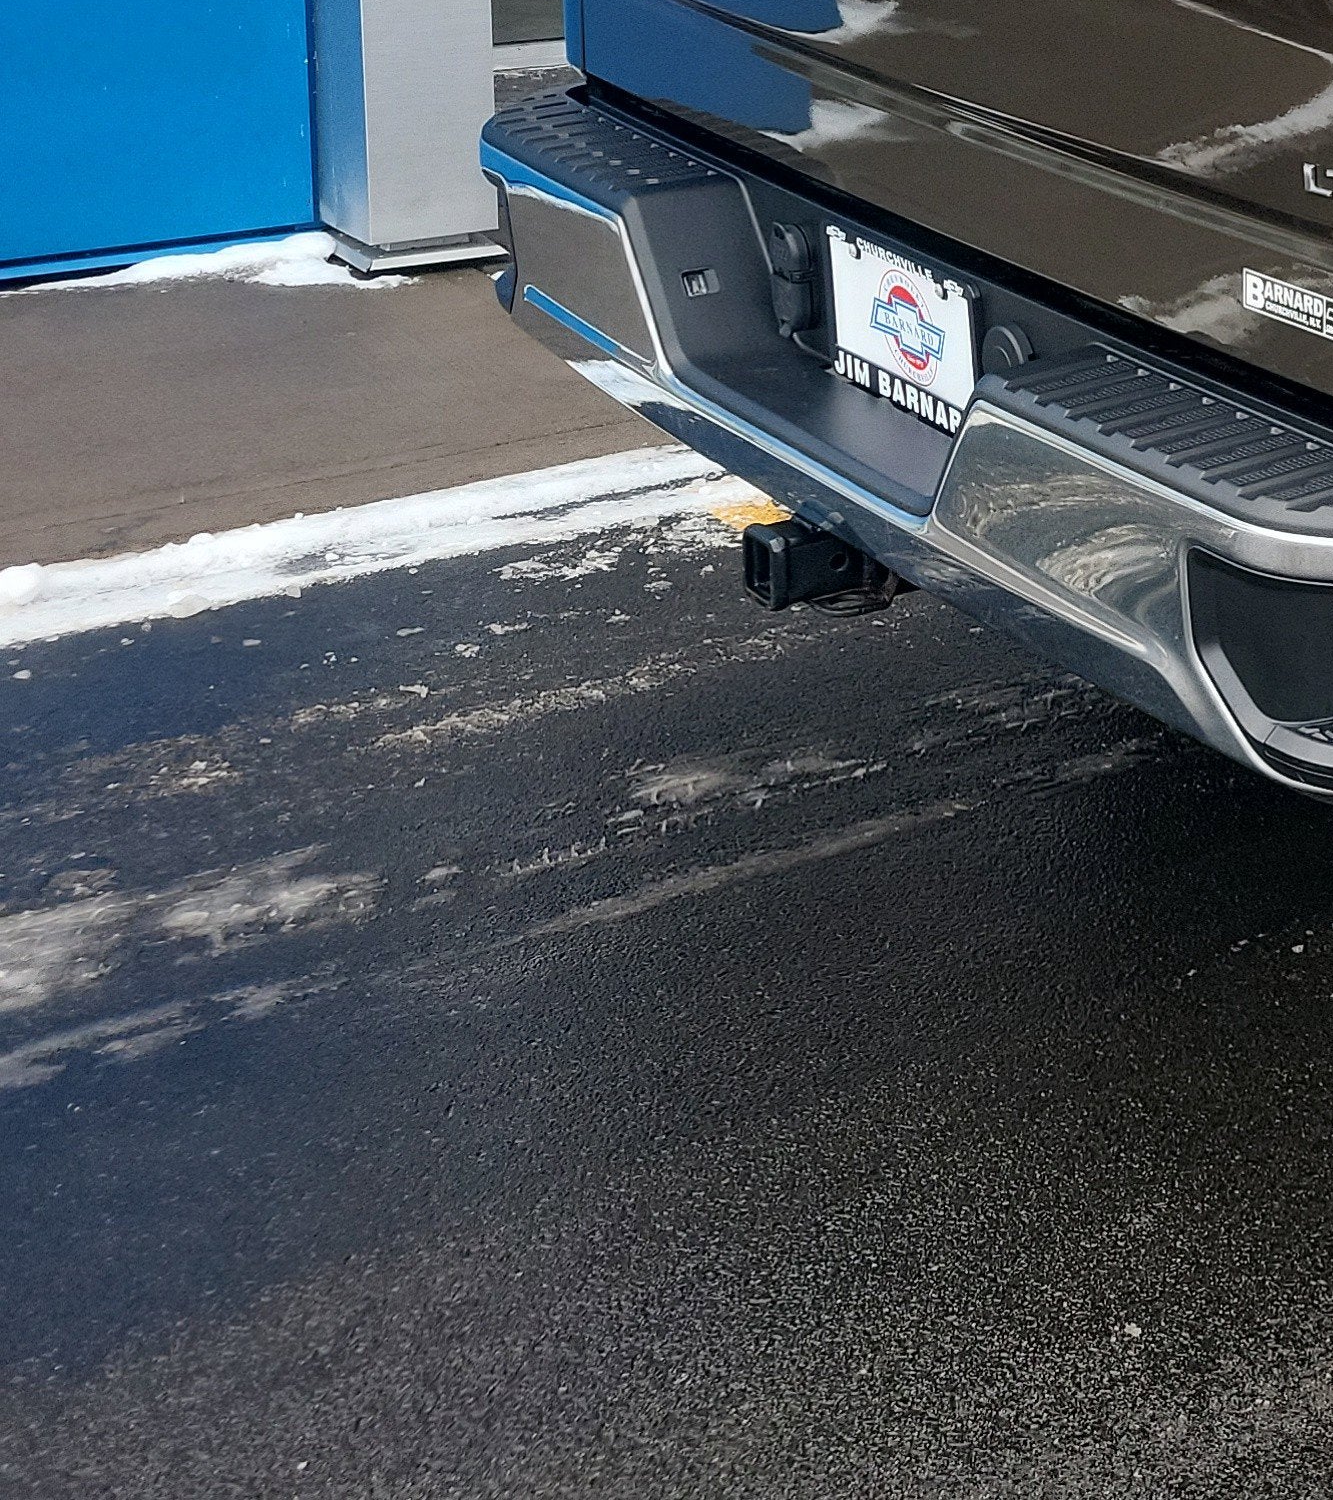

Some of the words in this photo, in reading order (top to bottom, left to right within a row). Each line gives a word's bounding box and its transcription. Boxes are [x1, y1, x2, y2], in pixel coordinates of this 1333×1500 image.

[856, 237, 934, 281] CHURCHVILLE
[1246, 273, 1324, 318] BARNARD
[883, 311, 935, 347] BARNARD
[834, 350, 870, 388] JIM
[878, 369, 962, 434] BARNAR
